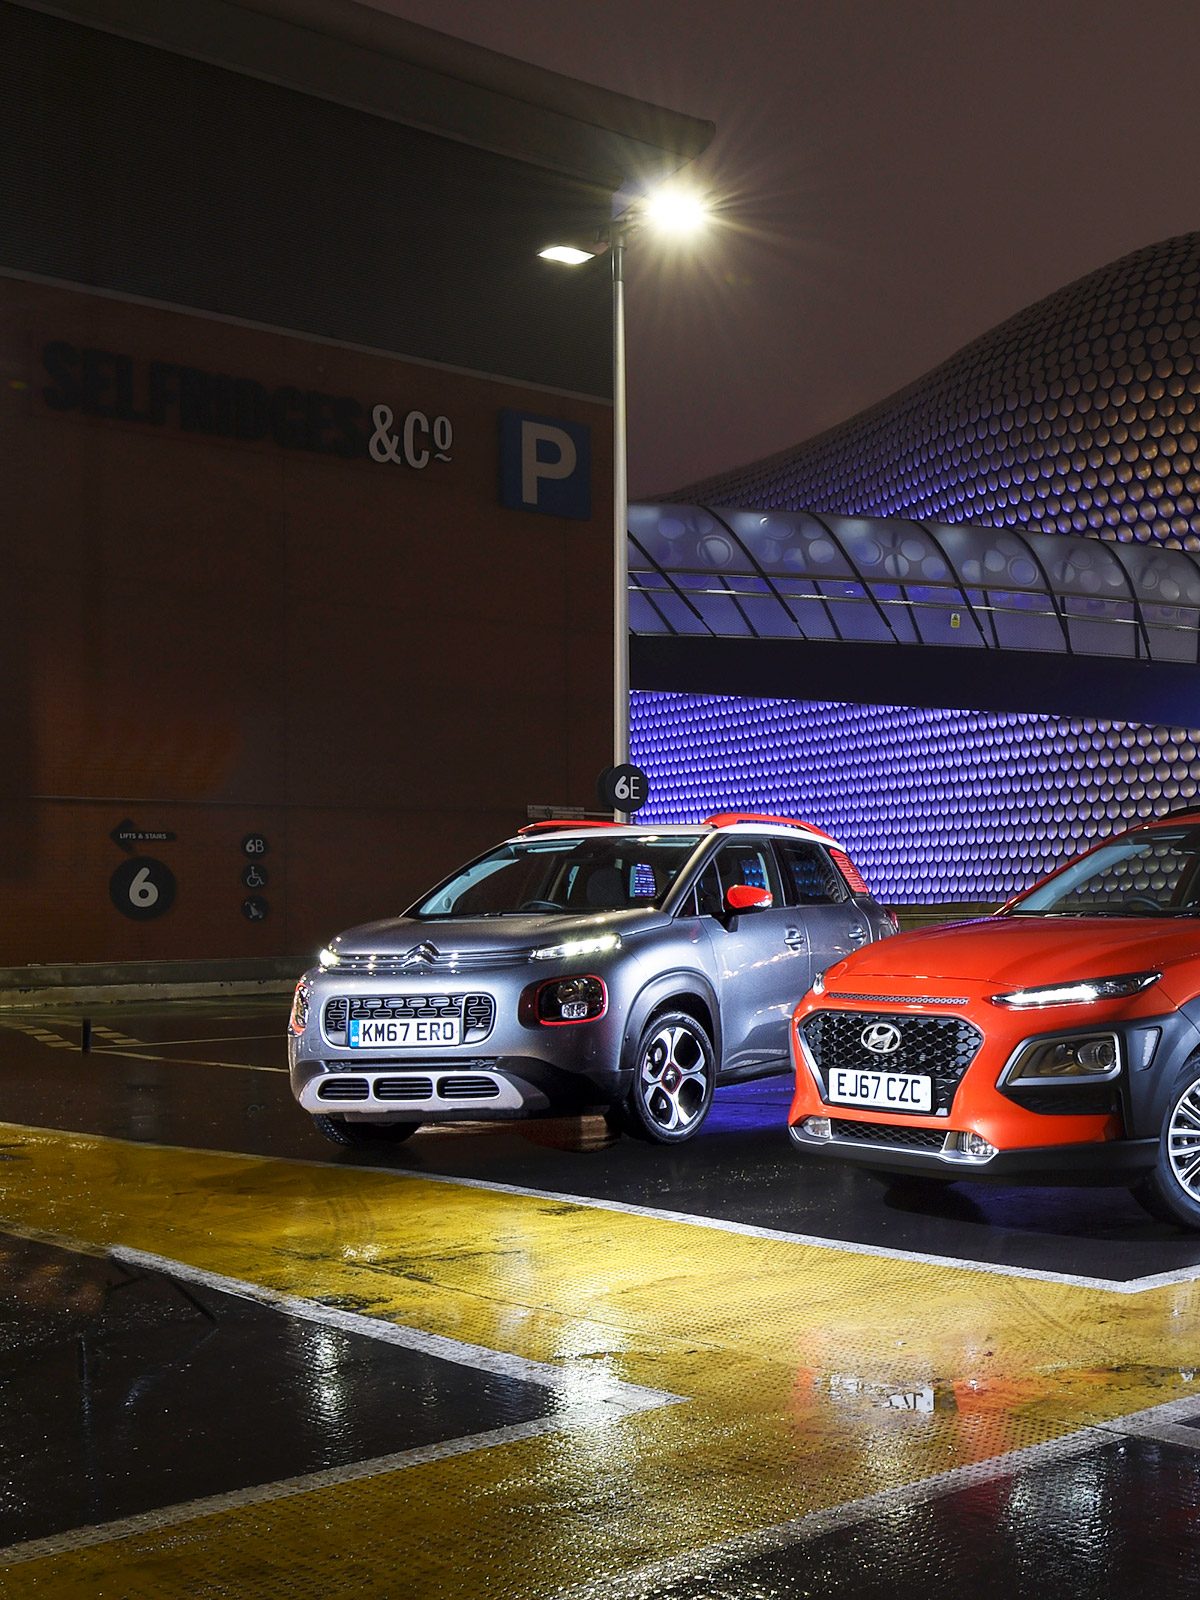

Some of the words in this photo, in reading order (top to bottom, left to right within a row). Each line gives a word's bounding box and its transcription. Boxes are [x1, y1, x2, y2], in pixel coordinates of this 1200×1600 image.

[521, 419, 577, 505] P
[614, 775, 641, 800] 6E
[119, 832, 137, 840] LIFTS
[245, 839, 265, 853] 6B
[128, 866, 159, 908] 6
[362, 1022, 411, 1042] KM67
[416, 1021, 454, 1041] ERO
[837, 1072, 881, 1099] EJ67
[887, 1077, 921, 1104] CZC
